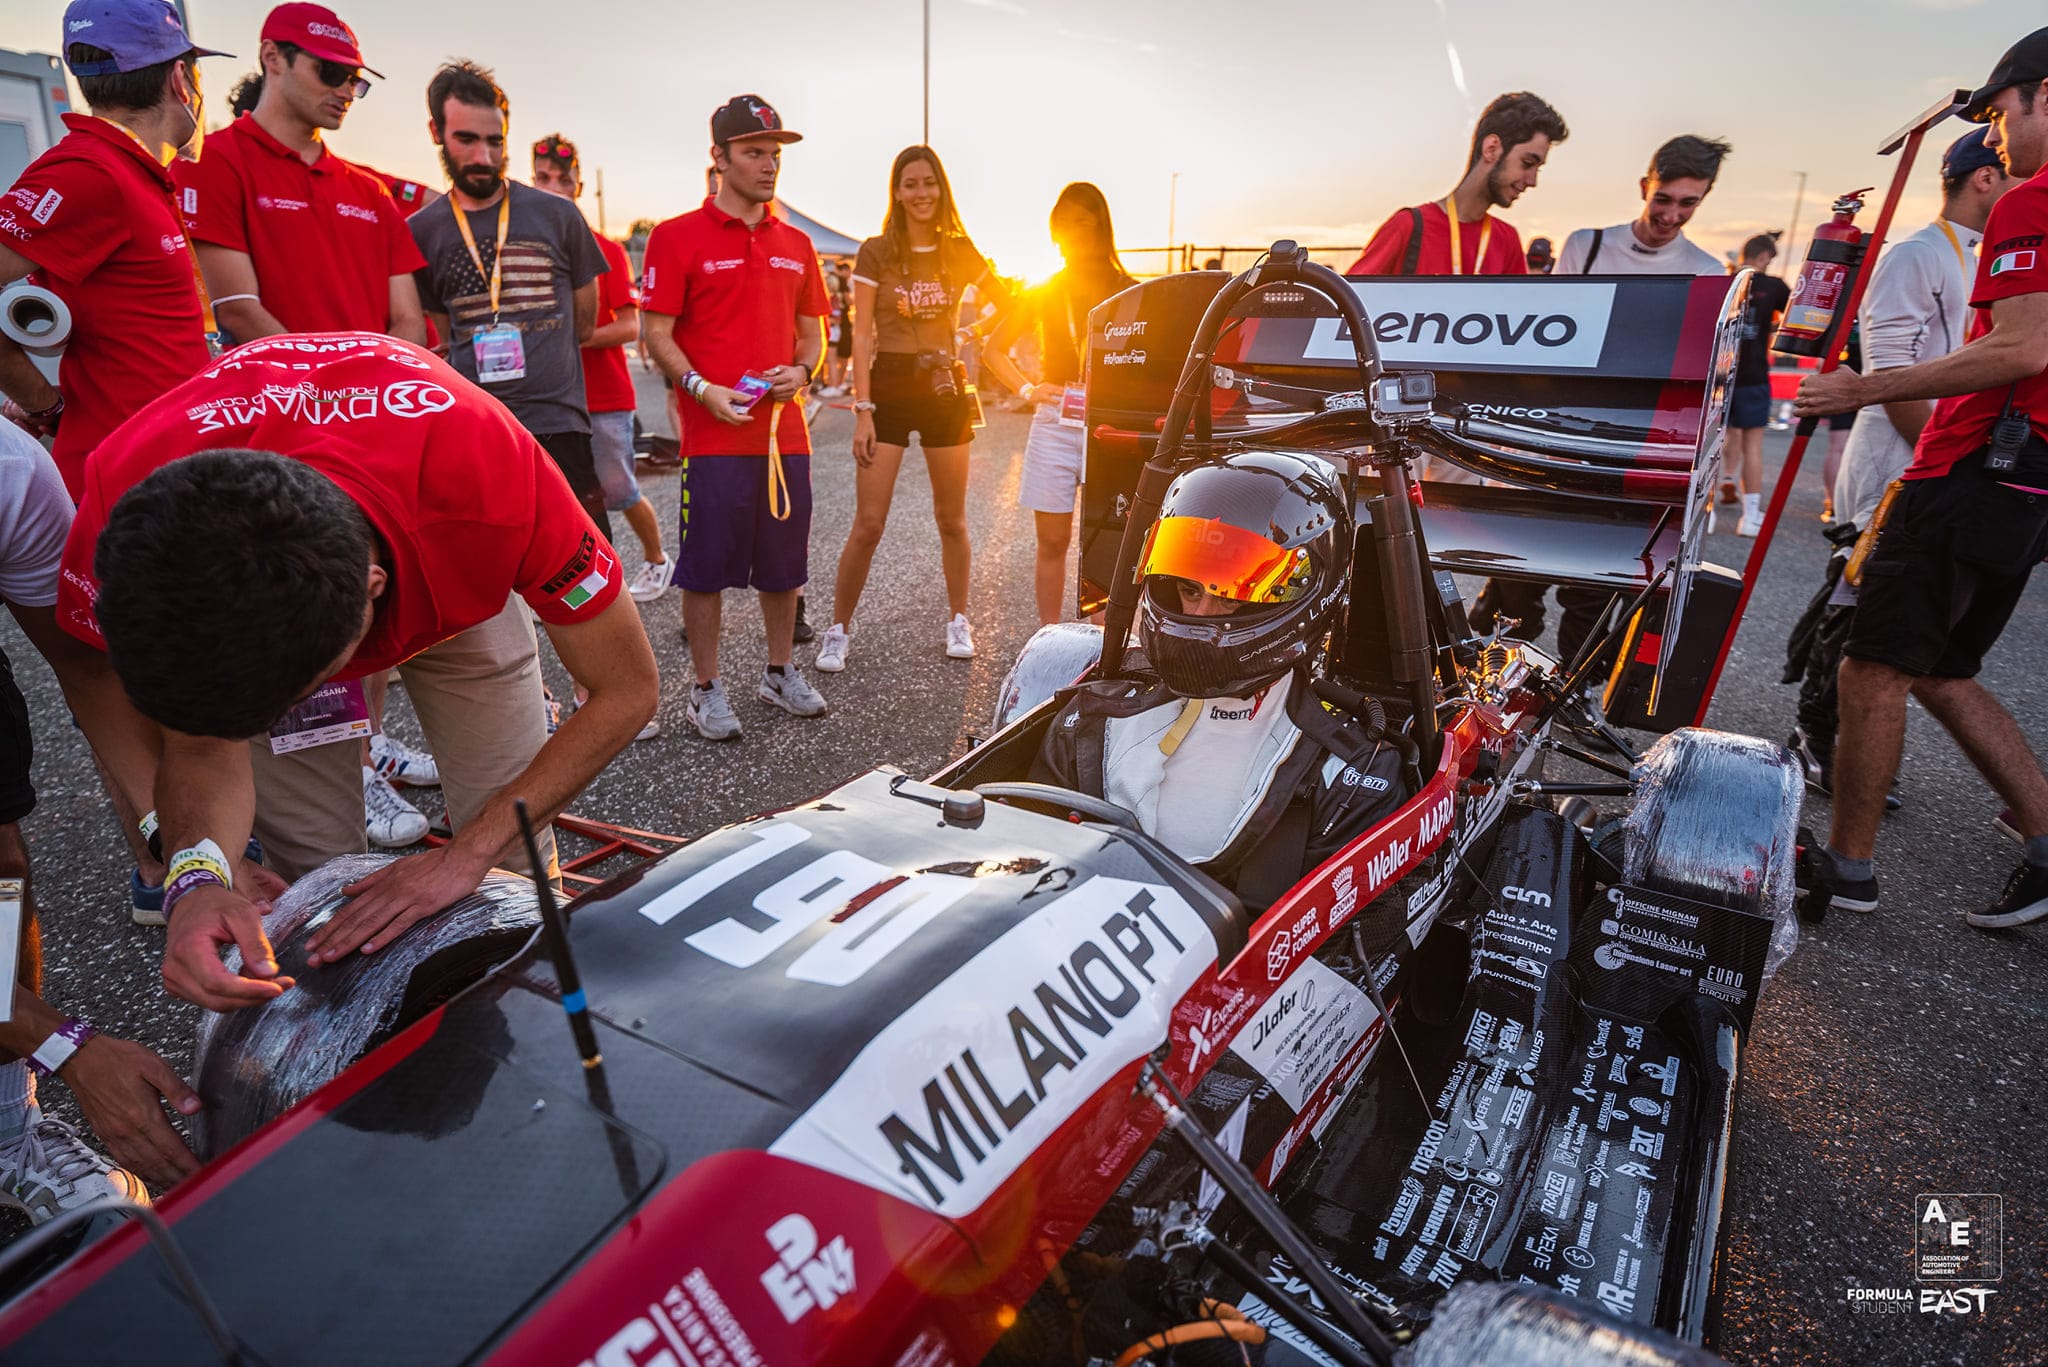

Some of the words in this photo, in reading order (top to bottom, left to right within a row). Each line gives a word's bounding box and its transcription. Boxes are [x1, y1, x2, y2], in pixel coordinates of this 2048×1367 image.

[37, 194, 58, 220] Lenovo
[323, 385, 378, 400] POLIMI
[541, 531, 595, 594] PIRELLI
[1210, 705, 1252, 721] freem
[1345, 767, 1387, 790] freem
[1367, 836, 1413, 891] Weller
[1292, 907, 1317, 938] SUPER
[1486, 909, 1516, 923] Auto
[1530, 920, 1558, 936] Arte
[1625, 899, 1661, 913] OFFICINE
[1661, 908, 1699, 923] MIGNANI
[1292, 922, 1320, 957] FORMA
[1619, 933, 1650, 946] OFFICINA
[1620, 923, 1707, 956] COMI&SALA
[1612, 949, 1655, 967] Dimensione
[1655, 961, 1679, 974] Laser
[1483, 969, 1542, 992] PUNTOZERO
[1707, 965, 1743, 988] EURO
[1698, 987, 1742, 1005] CIRCUITS
[1529, 1030, 1545, 1063] MUSP
[1621, 1025, 1645, 1051] Stilo
[1581, 1070, 1595, 1088] Add
[1474, 1095, 1492, 1123] CEFIS
[1564, 1105, 1580, 1133] Popolare
[1410, 1119, 1450, 1175] maxon
[1574, 1123, 1588, 1147] Sondrio
[1593, 1140, 1610, 1168] Software
[1540, 1170, 1567, 1215] TRATER
[1588, 1171, 1602, 1188] MSC
[1379, 1187, 1412, 1234] Power
[1587, 1200, 1599, 1222] SENSE
[1456, 1215, 1475, 1255] Valsecchi
[1531, 1226, 1560, 1271] EUREKA
